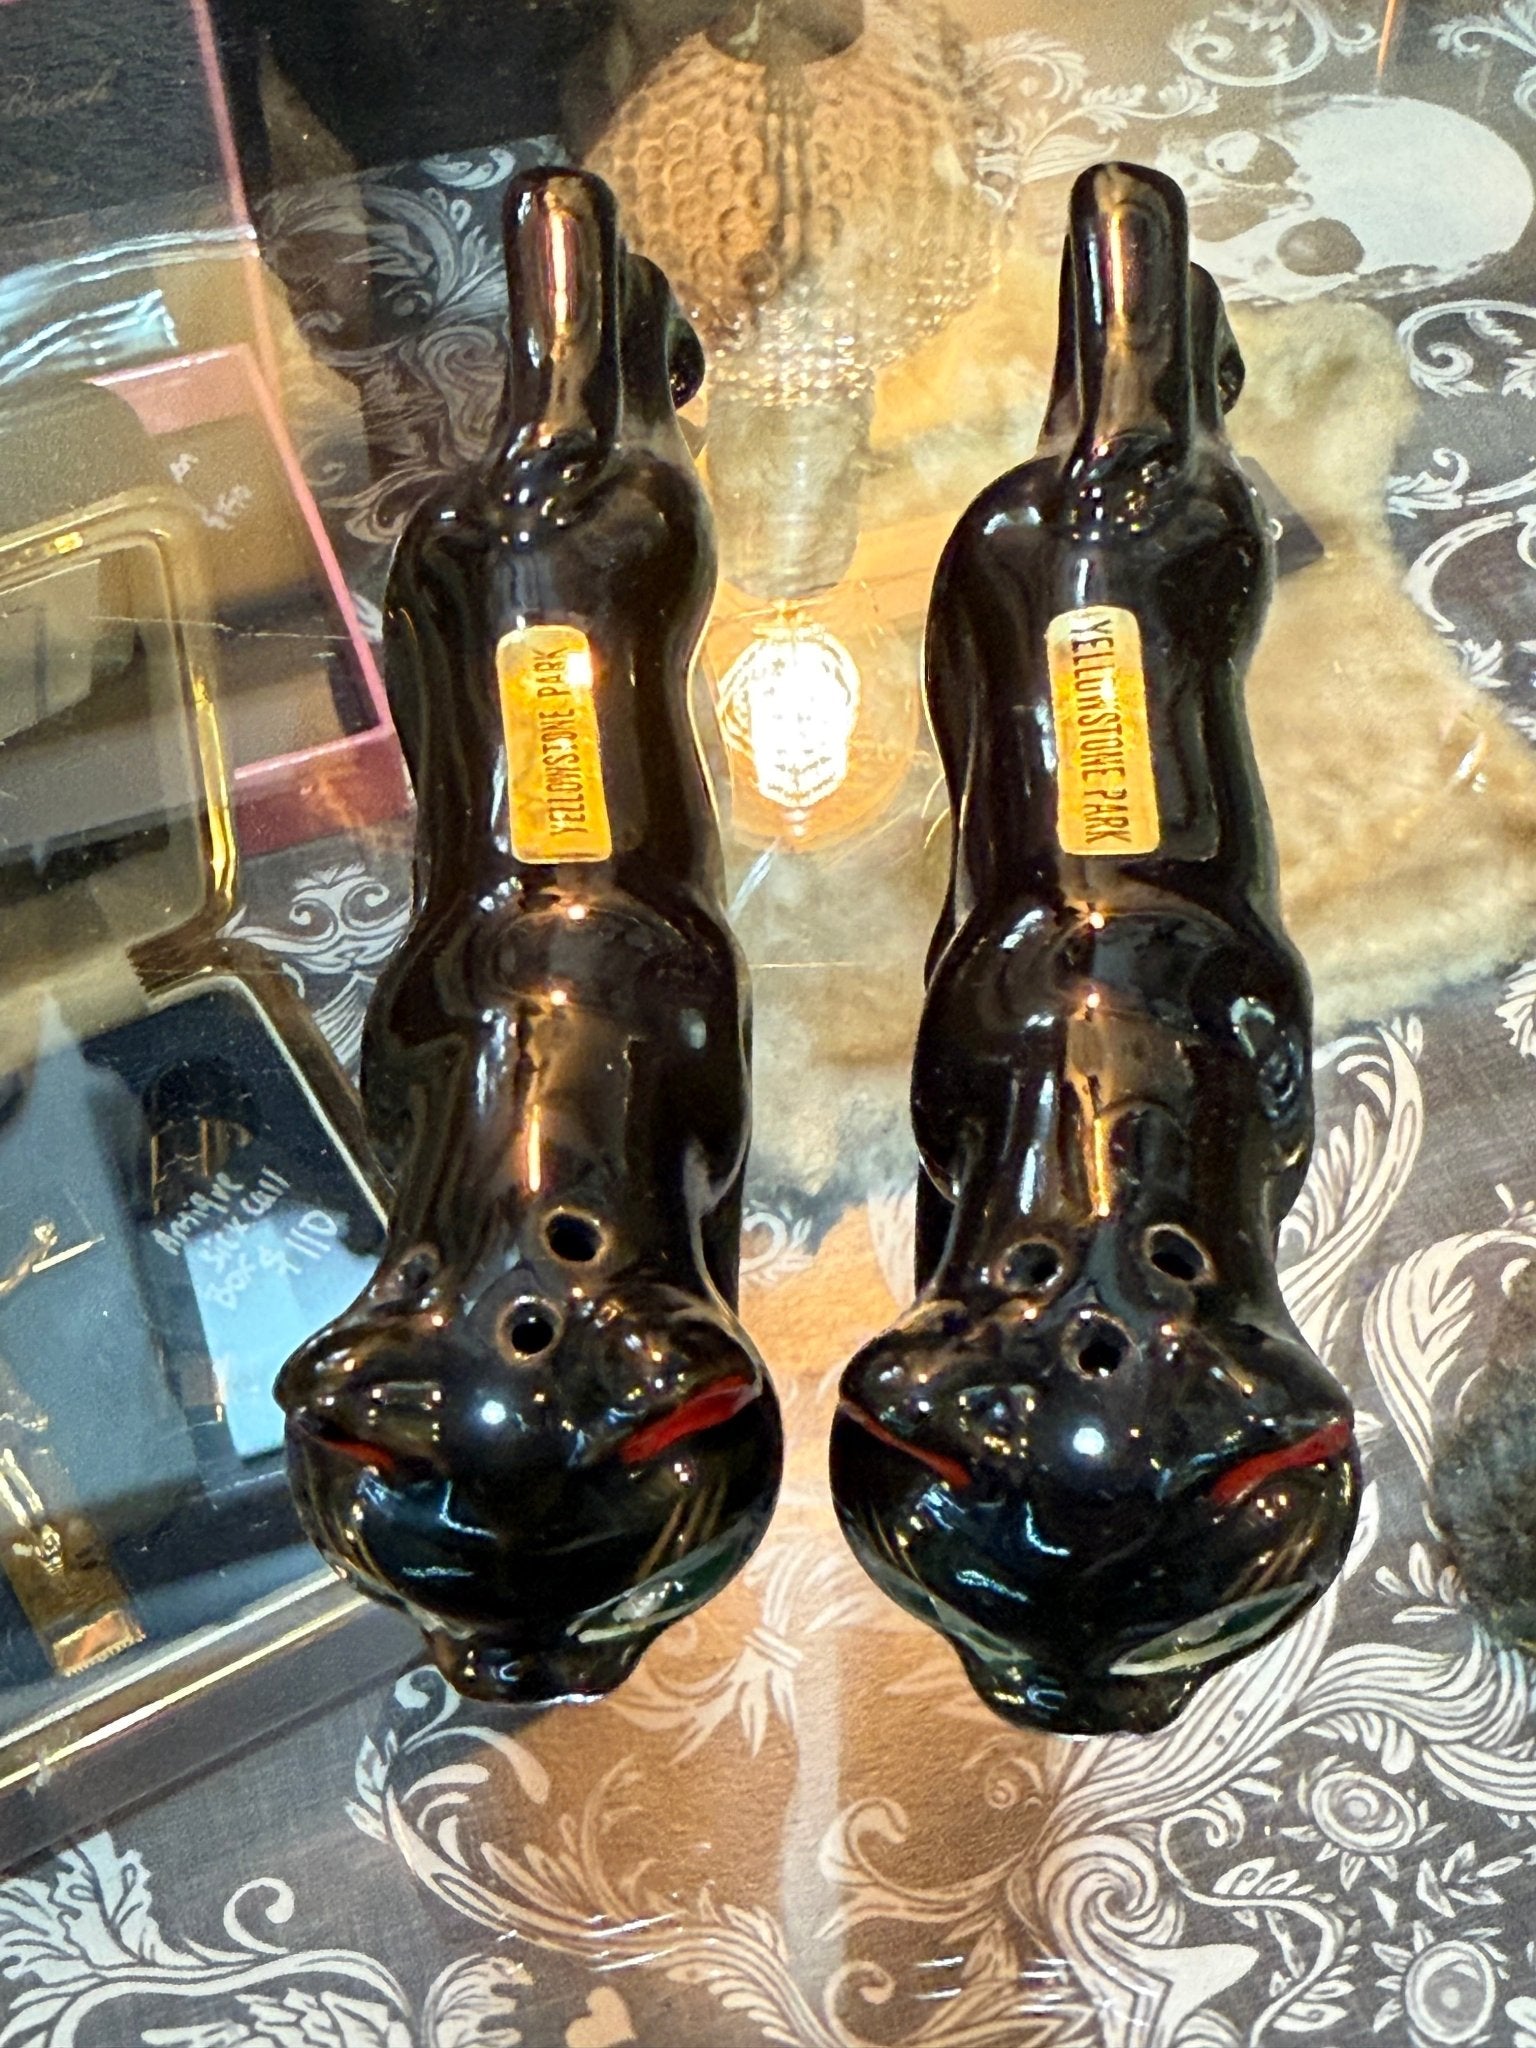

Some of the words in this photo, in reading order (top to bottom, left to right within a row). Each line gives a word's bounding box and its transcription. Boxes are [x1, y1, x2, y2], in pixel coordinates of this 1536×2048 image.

[532, 646, 574, 699] PARK
[1070, 618, 1126, 783] YELLOWSTONE
[538, 707, 589, 837] YELLOWSTONE
[1083, 787, 1132, 844] PARK
